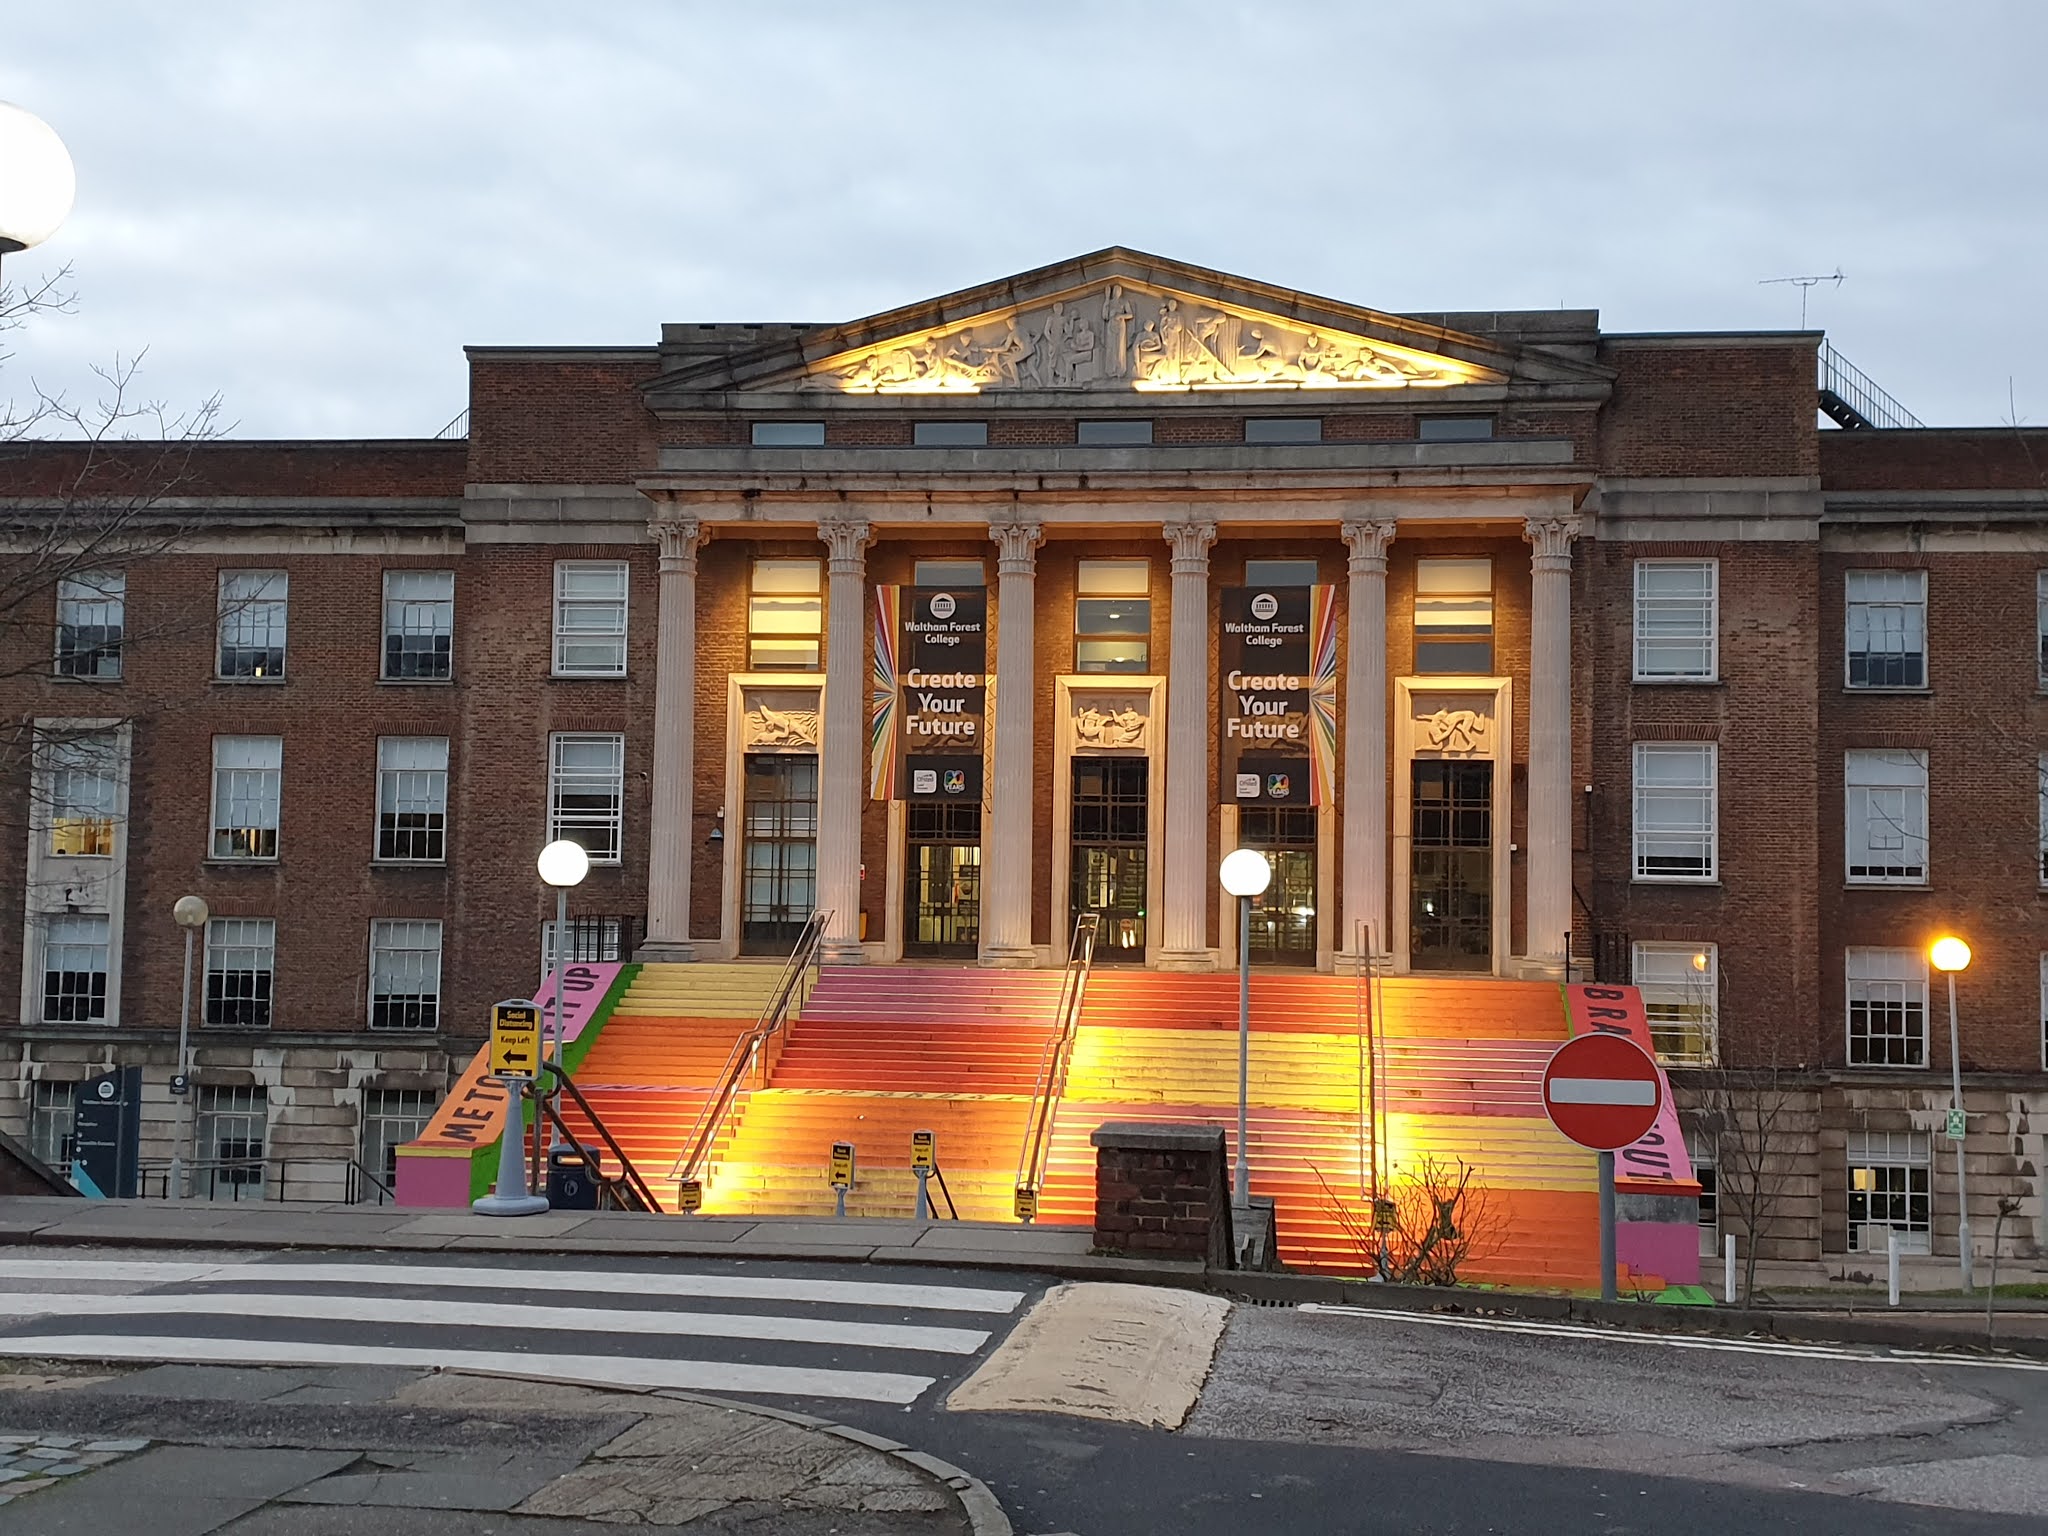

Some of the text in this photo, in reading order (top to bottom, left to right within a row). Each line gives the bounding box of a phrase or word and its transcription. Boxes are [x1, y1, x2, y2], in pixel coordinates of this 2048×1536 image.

[905, 621, 980, 633] Waltham Forest
[1225, 622, 1304, 634] Waltham Forest
[925, 633, 960, 646] College
[1246, 635, 1282, 647] College
[907, 669, 976, 689] Create
[1228, 670, 1299, 691] Create
[918, 693, 965, 713] Your
[1239, 695, 1288, 715] Your
[906, 715, 975, 735] Future
[1227, 718, 1299, 738] Future
[563, 966, 600, 992] UP
[507, 1010, 526, 1019] Social
[500, 1019, 532, 1029] Distancing
[500, 1036, 530, 1045] Keep Left
